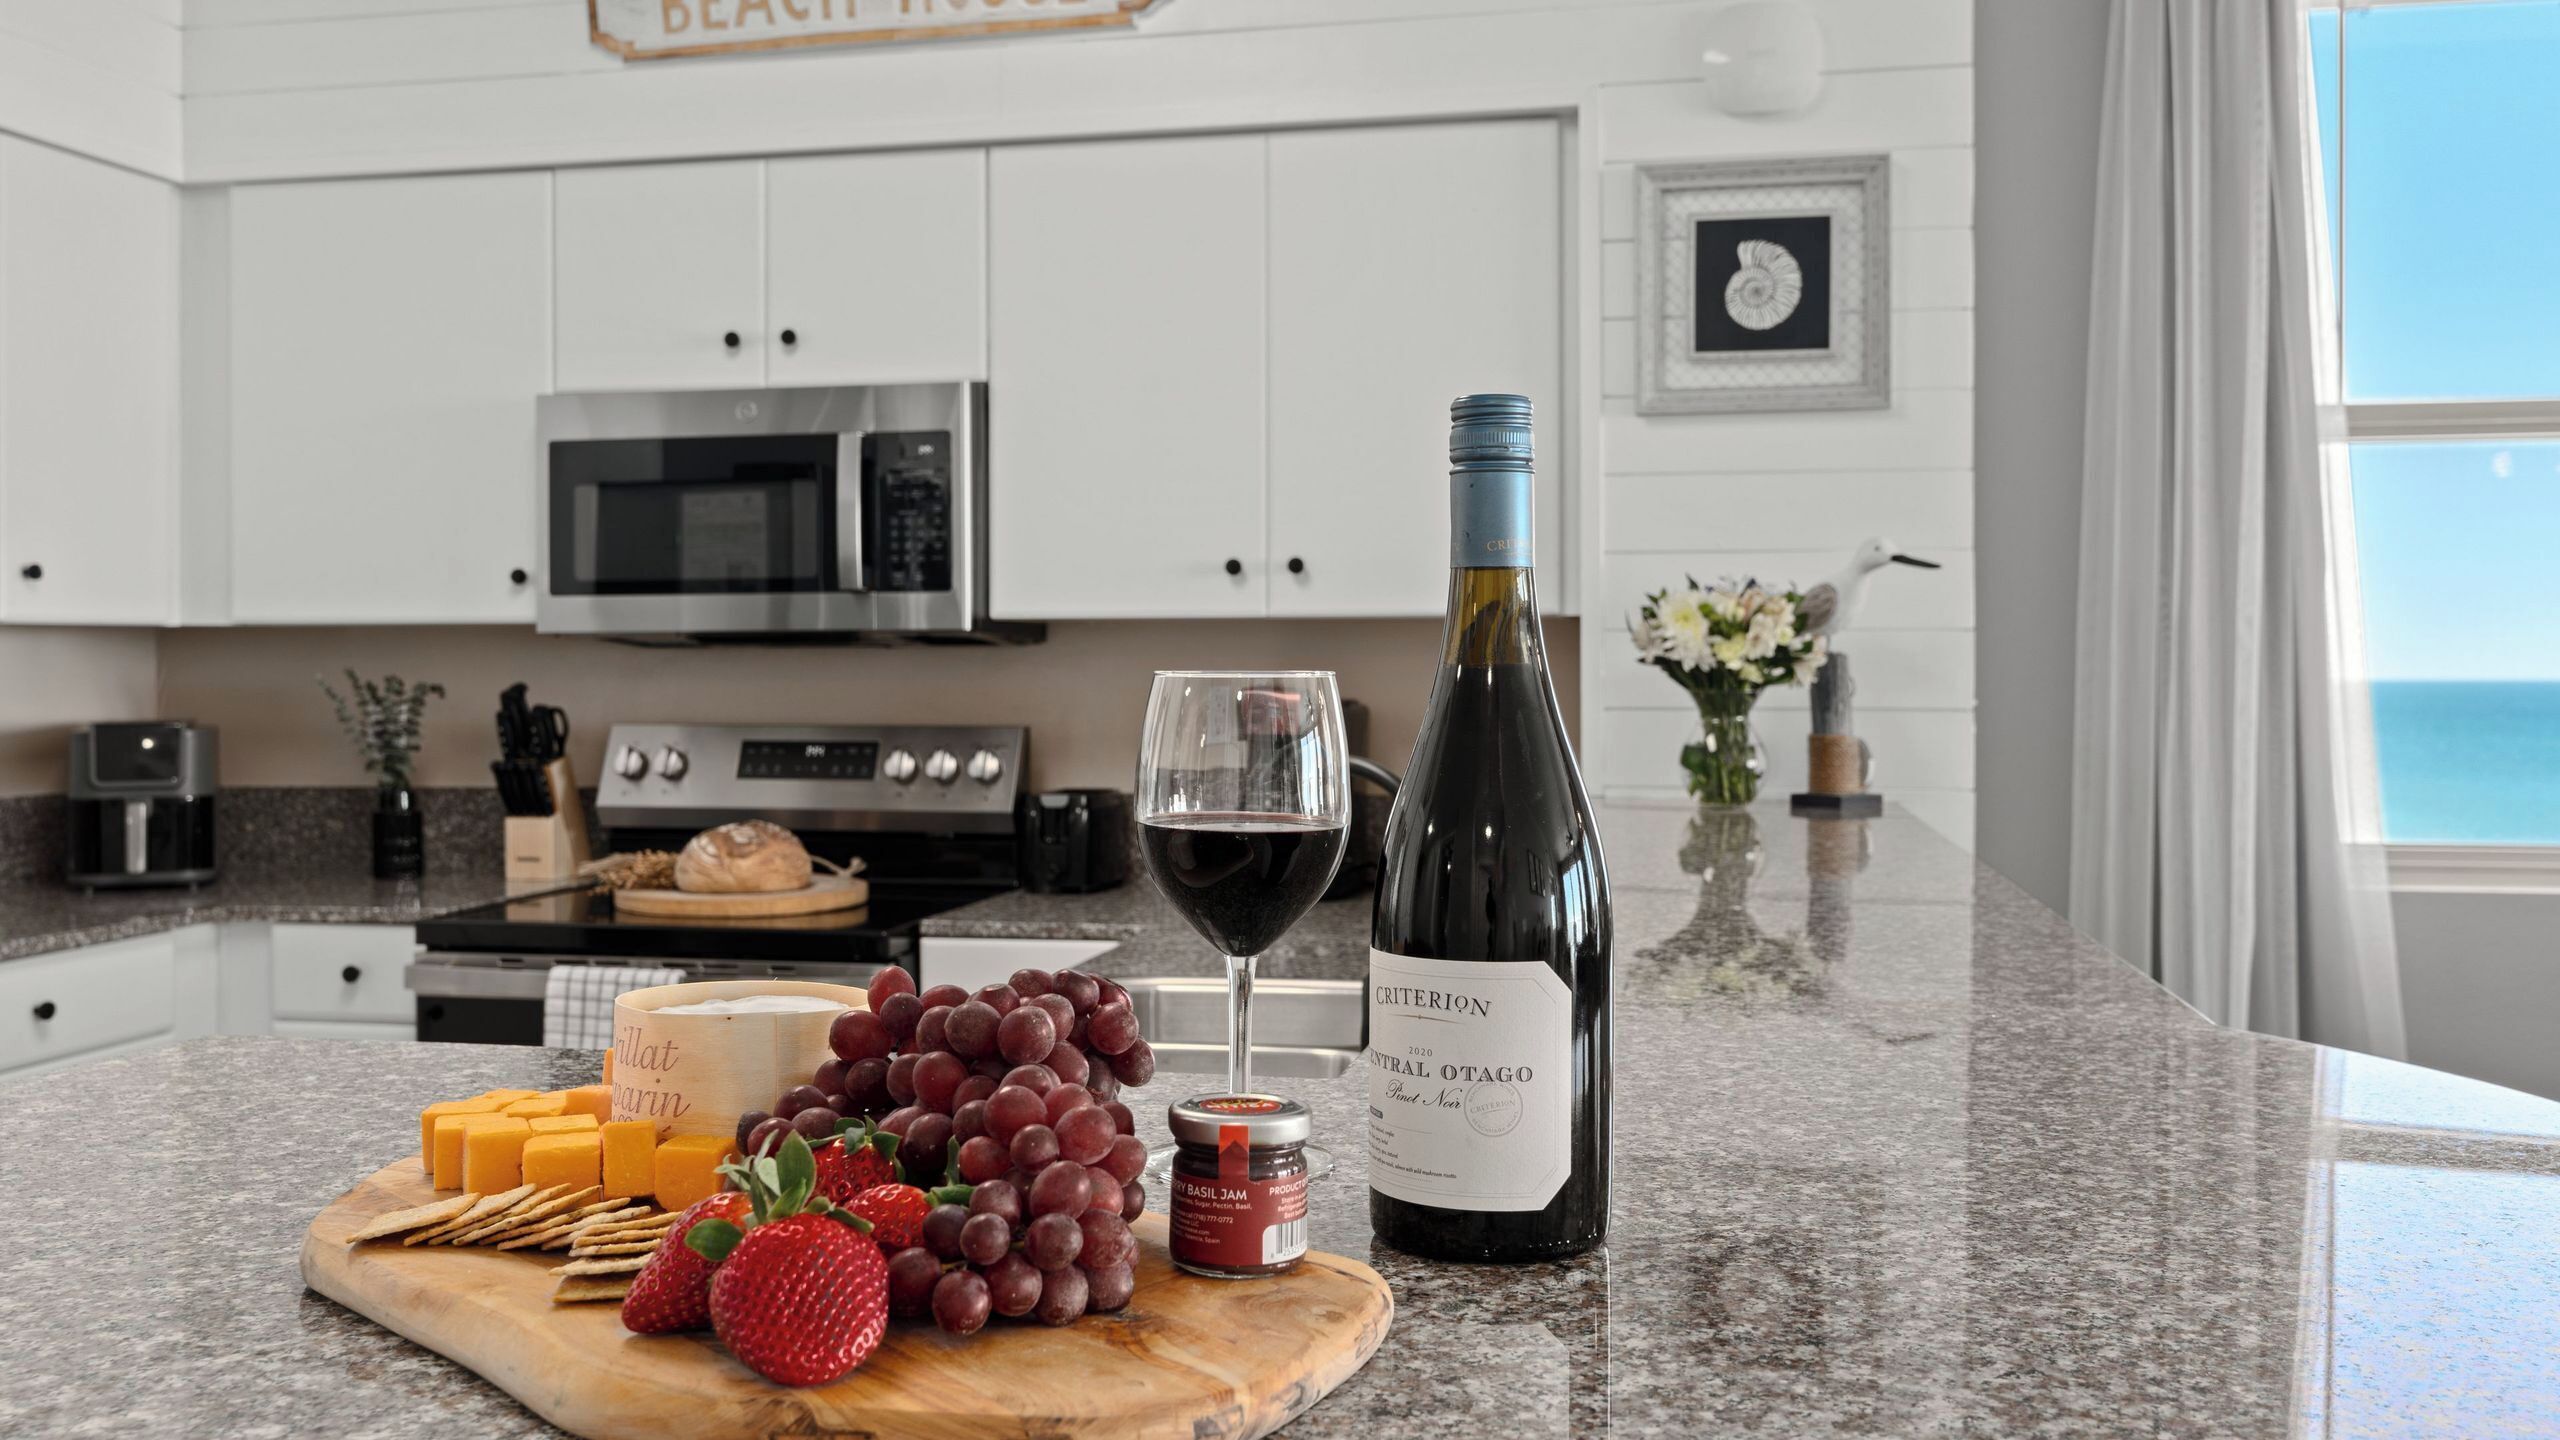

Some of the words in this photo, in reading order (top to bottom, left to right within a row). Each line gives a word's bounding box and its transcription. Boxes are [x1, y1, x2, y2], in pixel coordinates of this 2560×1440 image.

[1376, 985, 1492, 1017] CRITERION
[614, 1025, 679, 1072] rillat
[1408, 1046, 1433, 1057] 2020
[1370, 1047, 1430, 1078] ENTRAL
[1440, 1064, 1533, 1083] OTAGO
[613, 1078, 691, 1118] varin
[1386, 1079, 1420, 1104] Pinot
[1422, 1087, 1463, 1109] Noir
[1187, 1183, 1217, 1199] BASIL
[1220, 1188, 1247, 1200] JAM
[1269, 1180, 1302, 1196] PRODUCT
